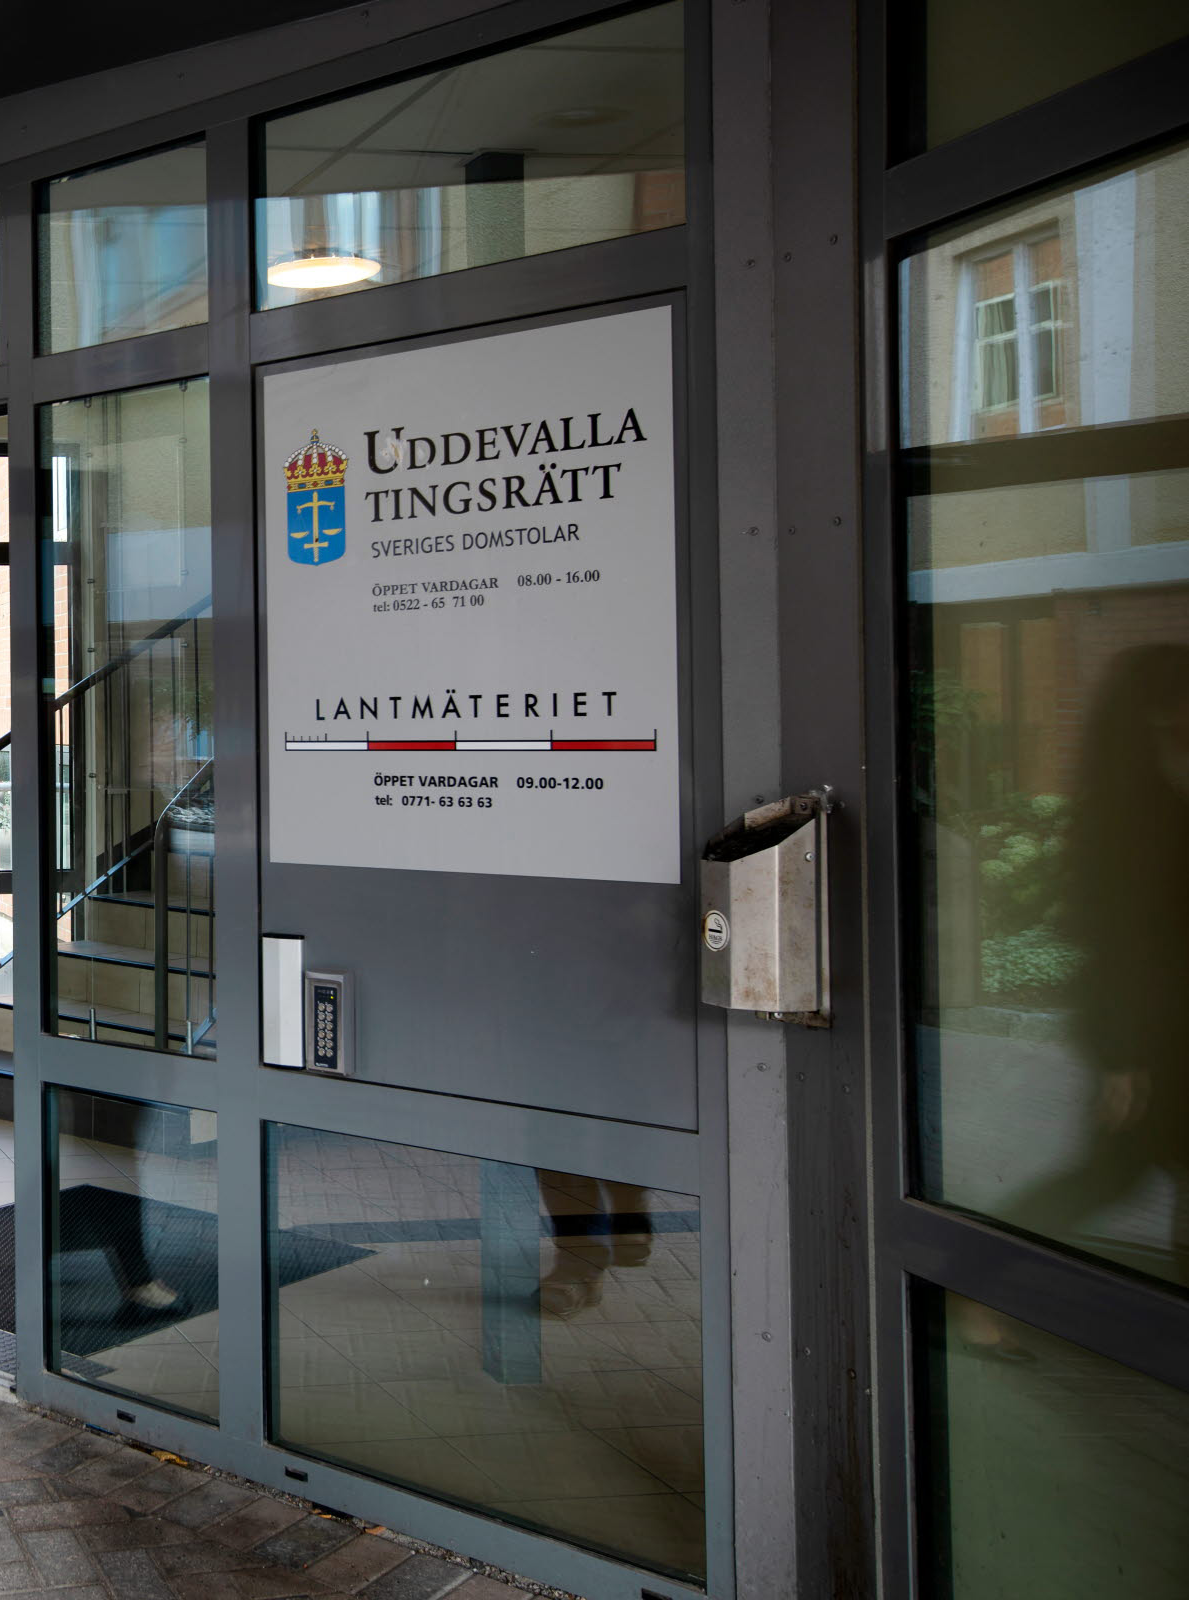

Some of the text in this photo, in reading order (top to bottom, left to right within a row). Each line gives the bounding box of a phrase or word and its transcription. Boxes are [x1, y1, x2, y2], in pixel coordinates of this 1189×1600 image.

[363, 407, 648, 475] UDDEVALLA
[364, 462, 623, 523] TINGSRÄTT
[370, 523, 580, 559] SVERIGES DOMSTOLAR
[371, 580, 418, 597] ÖPPET
[420, 577, 499, 593] VARDAGAR
[517, 573, 553, 587] 08.00
[565, 569, 601, 584] 16.00
[373, 601, 391, 613] tel:
[392, 599, 421, 612] 0522
[431, 596, 446, 609] 65
[452, 595, 467, 608] 71
[469, 594, 485, 607] 00
[315, 689, 618, 721] LANTMÄTERIET
[373, 772, 604, 791] ÖPPET VARDAGAR 09.00-12.00
[374, 795, 493, 809] tel: 0771- 63 63 63
